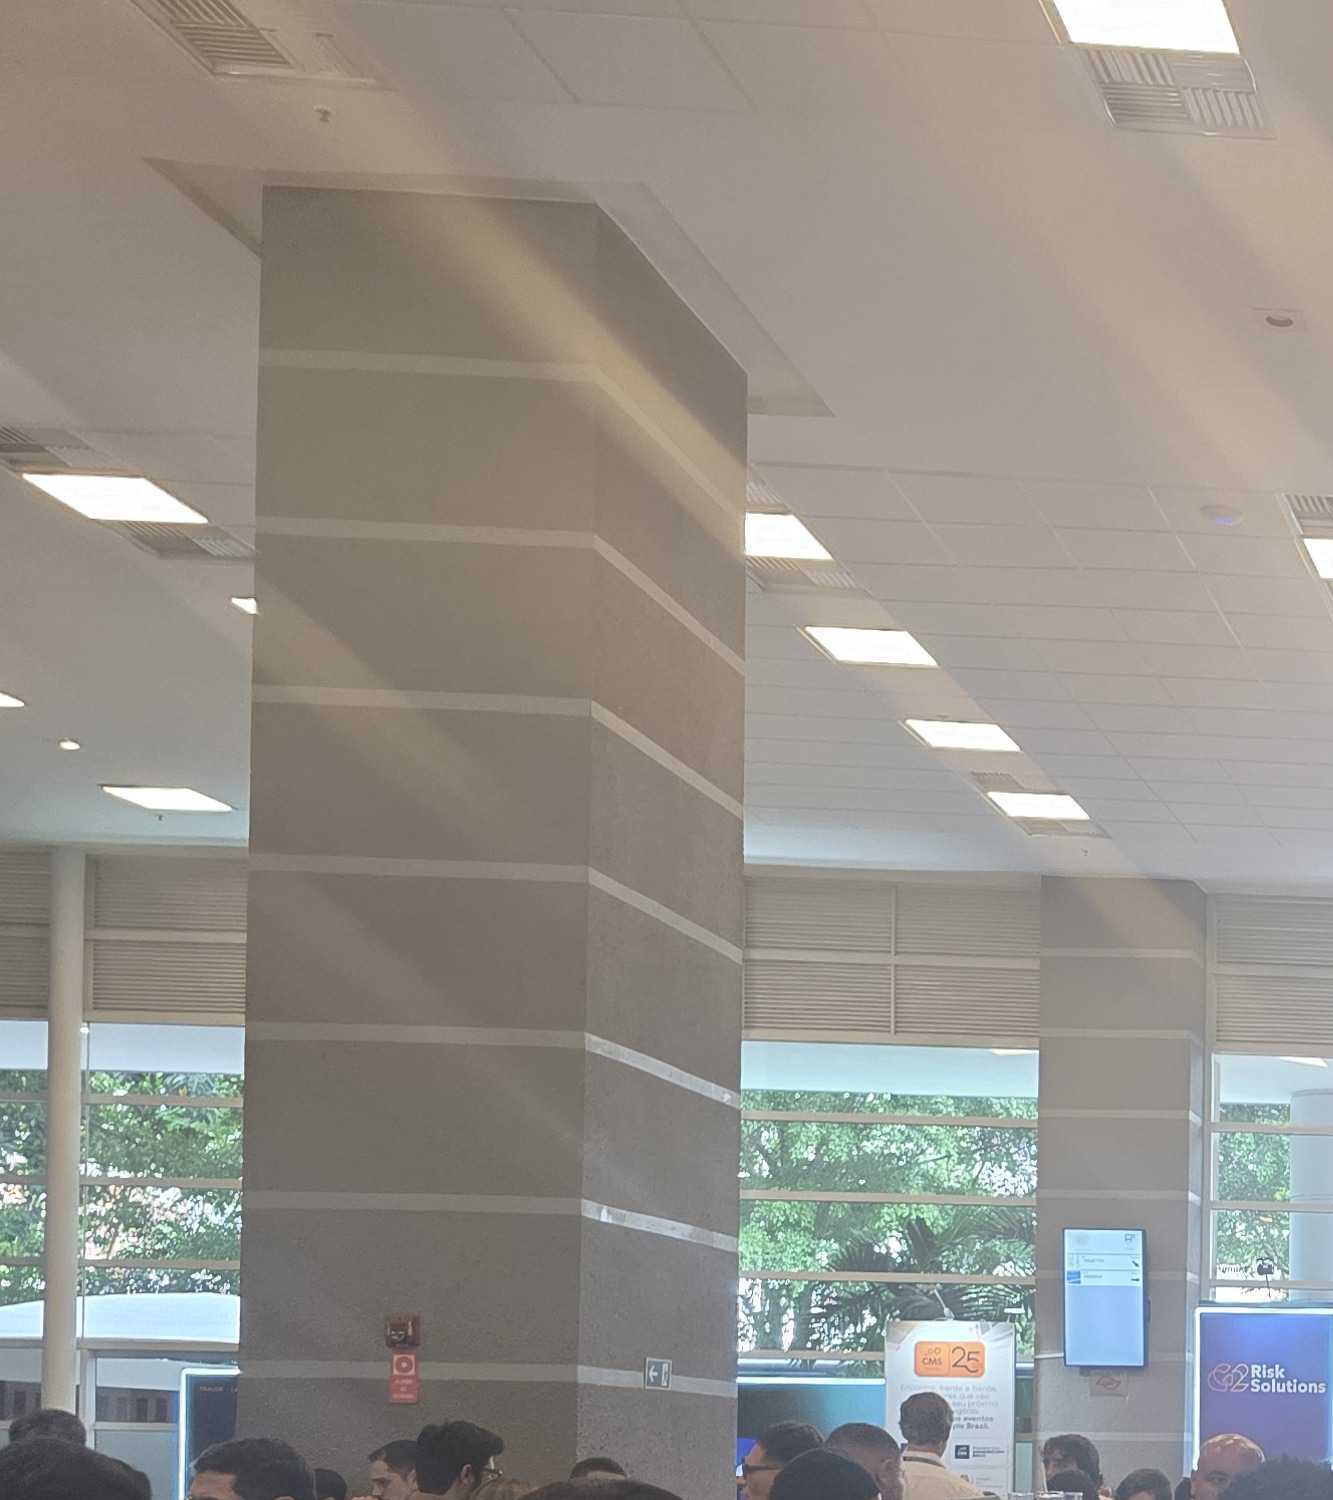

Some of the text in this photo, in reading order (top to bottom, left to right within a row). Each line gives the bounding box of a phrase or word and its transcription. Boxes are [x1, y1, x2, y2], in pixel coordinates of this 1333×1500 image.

[951, 1346, 980, 1374] 25
[1250, 1364, 1285, 1379] Risk
[1250, 1379, 1327, 1393] Solutions
